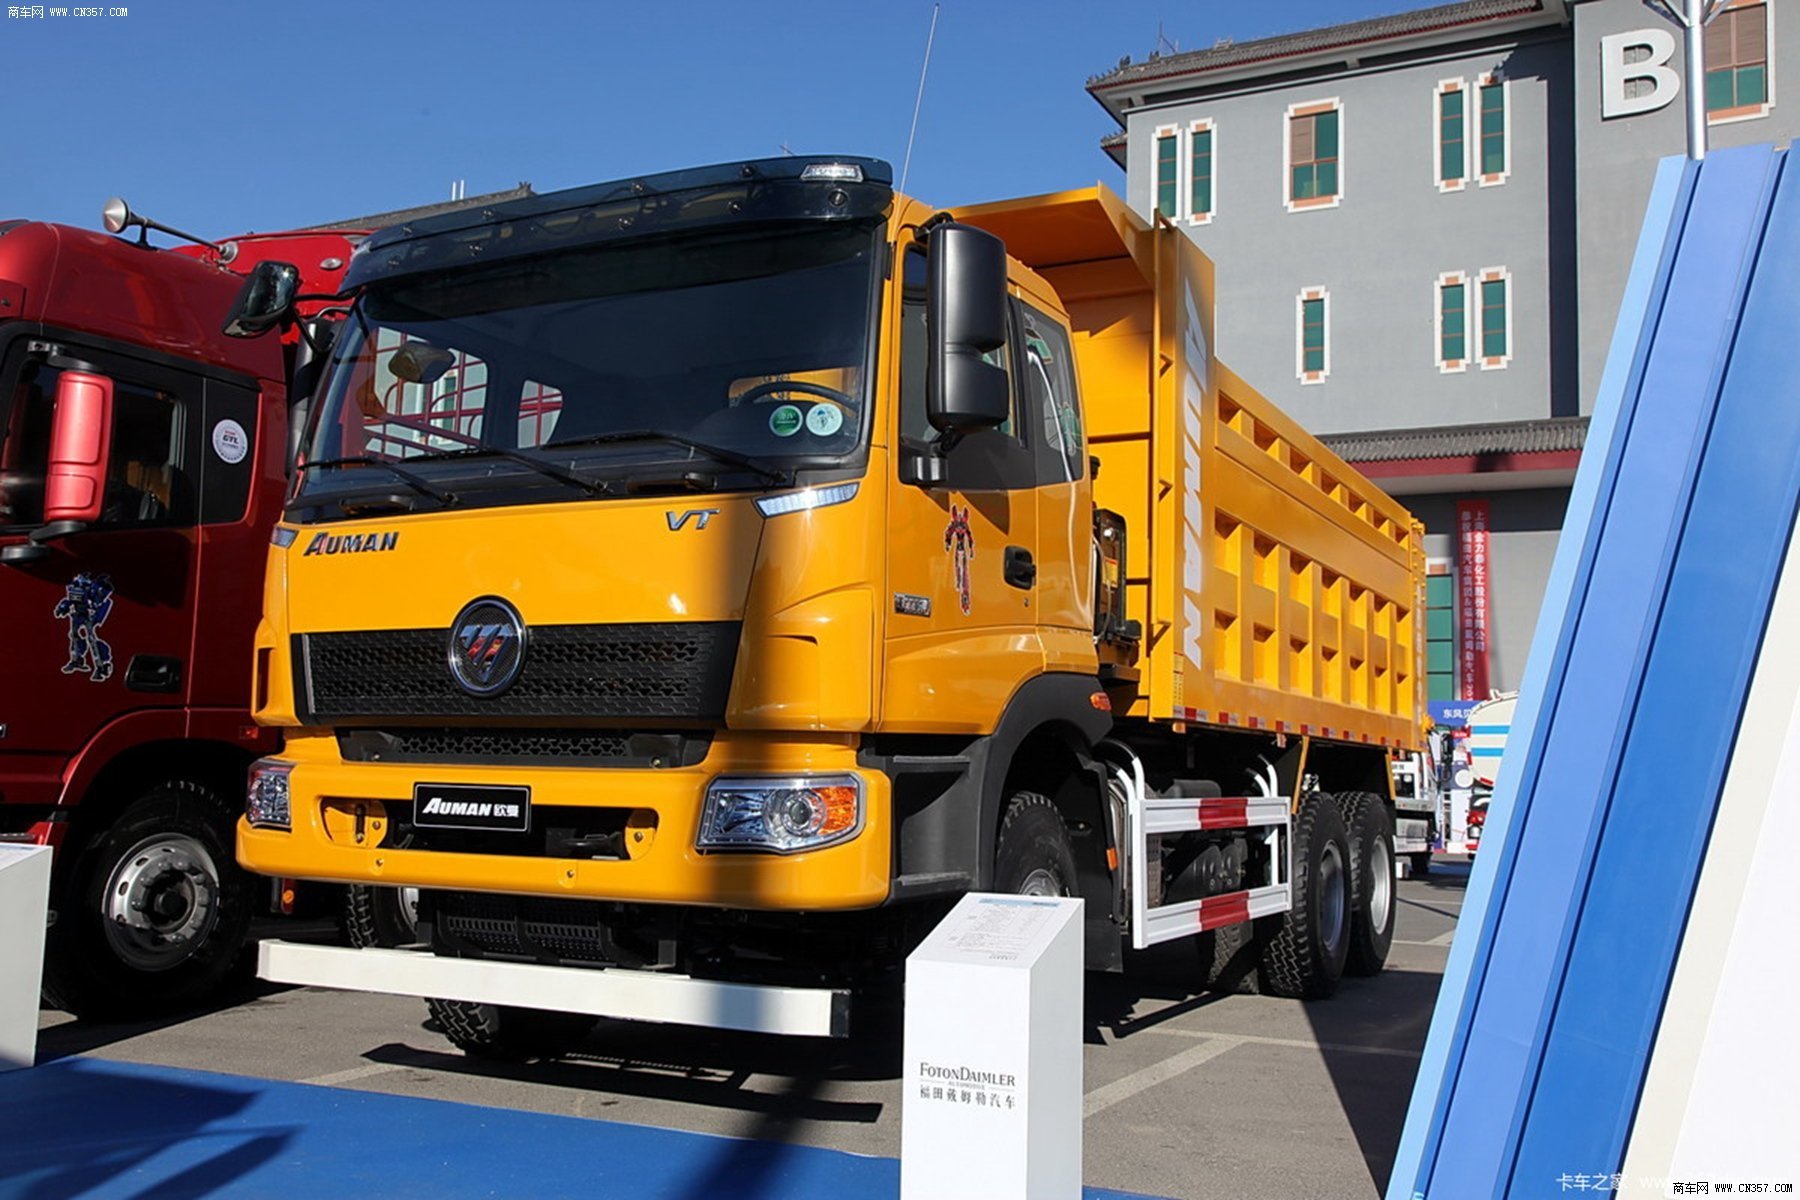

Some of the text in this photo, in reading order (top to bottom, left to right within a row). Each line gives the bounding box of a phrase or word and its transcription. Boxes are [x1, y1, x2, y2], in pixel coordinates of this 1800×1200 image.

[1600, 28, 1681, 121] B
[1184, 276, 1207, 671] AUMAN
[665, 508, 720, 531] VT
[303, 531, 399, 556] AUMAN
[422, 797, 492, 816] AUMAN
[920, 1084, 1016, 1109] 福田戴姆勒汽车
